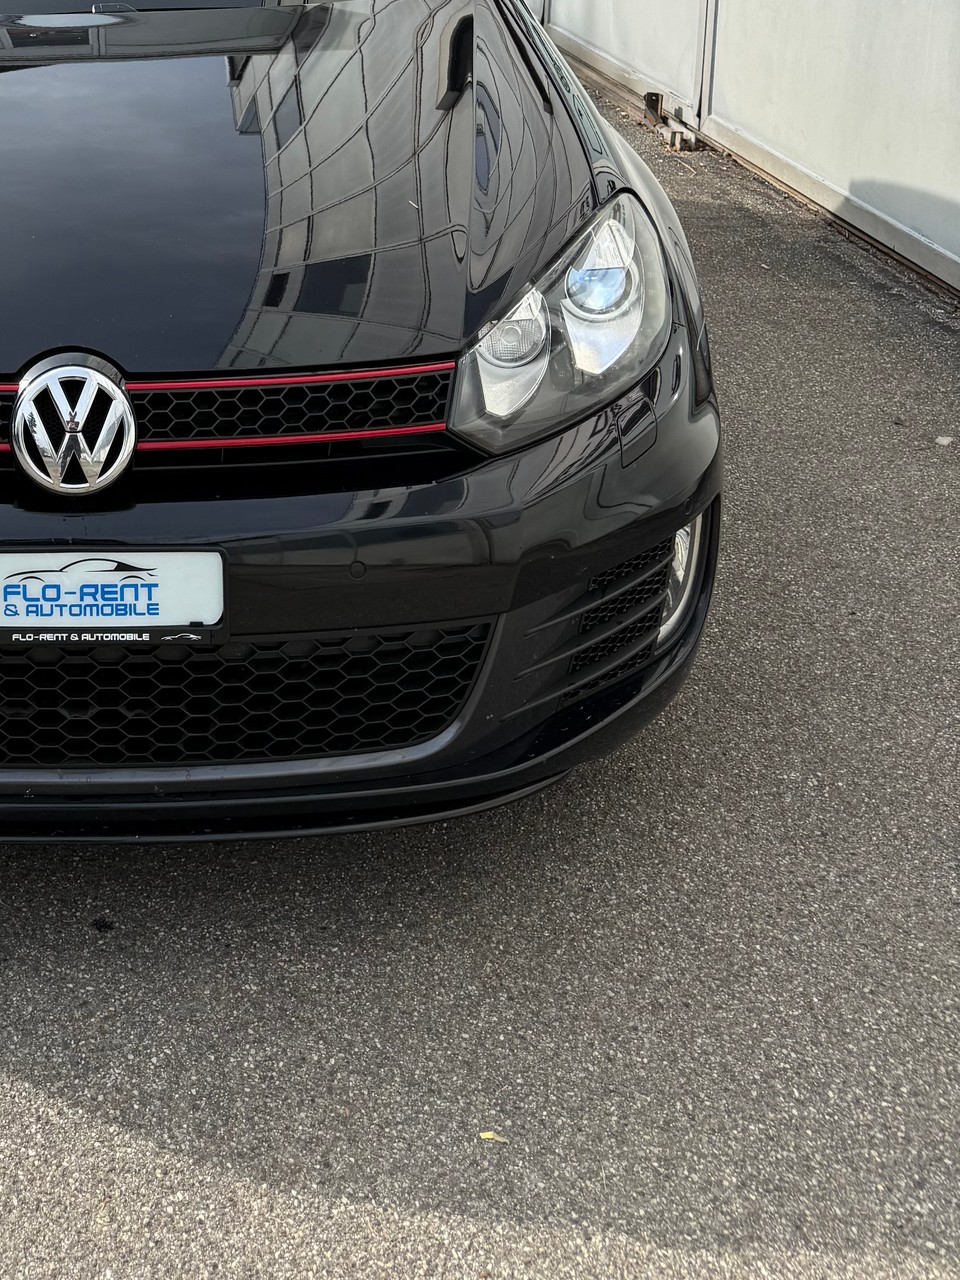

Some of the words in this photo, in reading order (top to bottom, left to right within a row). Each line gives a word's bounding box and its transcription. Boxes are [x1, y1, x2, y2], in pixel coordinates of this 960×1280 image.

[15, 367, 135, 493] VW
[3, 583, 159, 602] FLO-RENT
[3, 603, 20, 617] &
[25, 603, 160, 617] AUTOMOBILE
[12, 633, 69, 641] FLO-RENT
[70, 633, 79, 641] &
[81, 633, 150, 641] AUTOMOBILE
